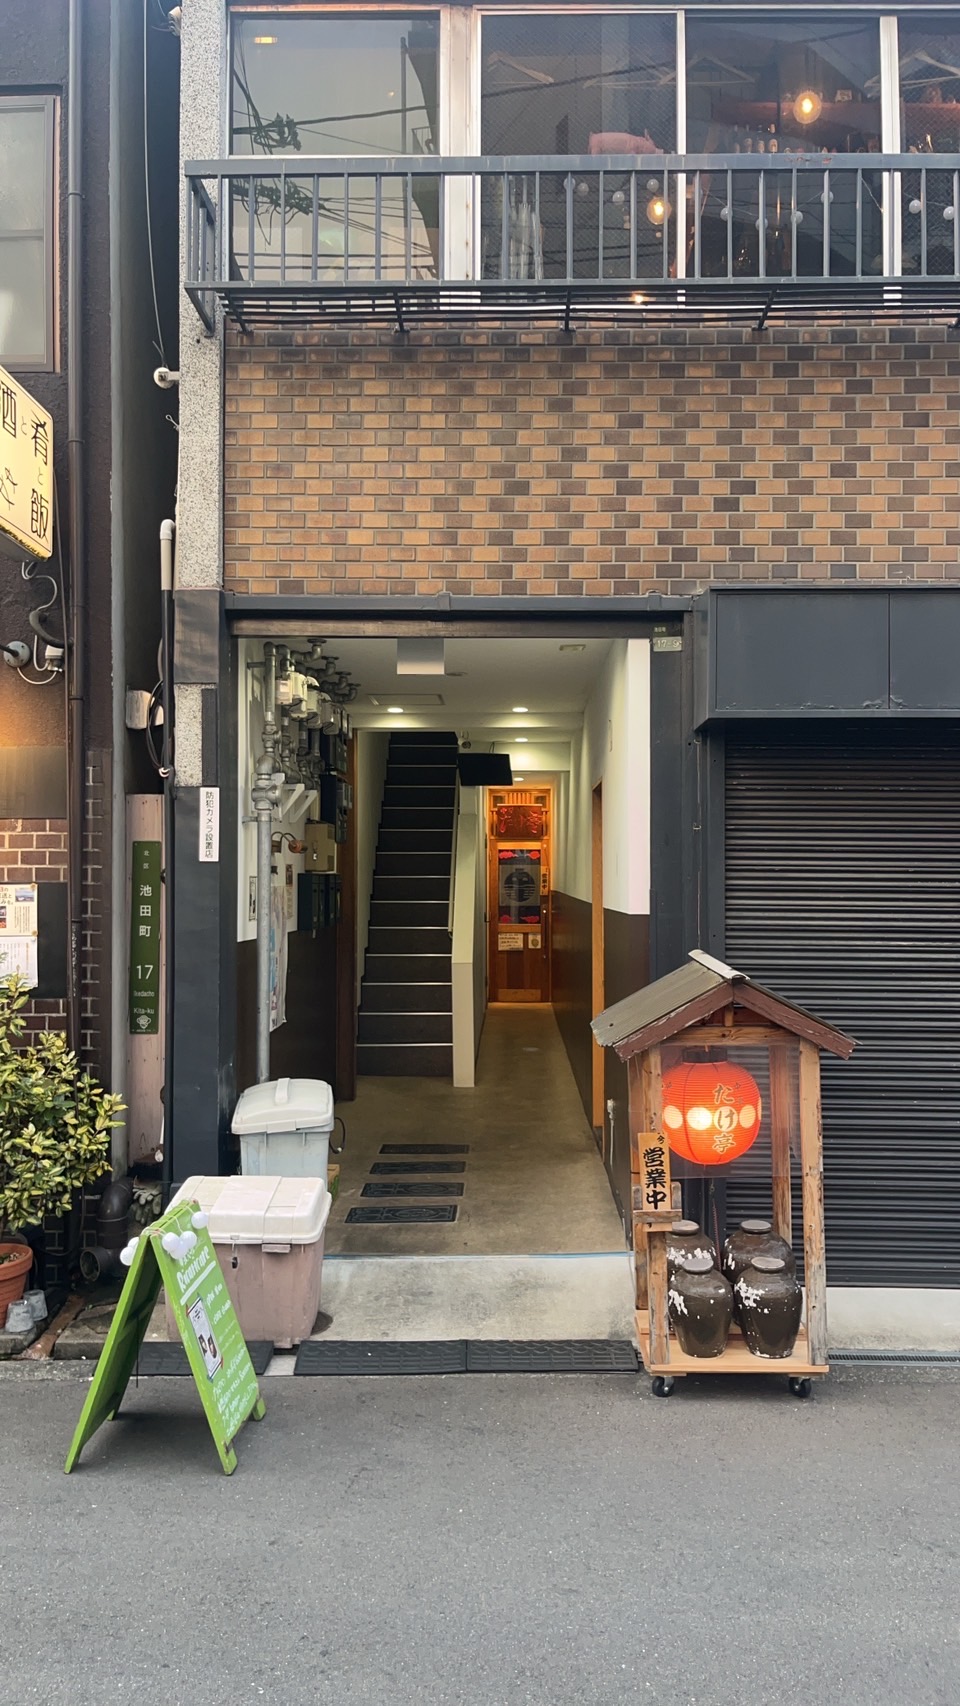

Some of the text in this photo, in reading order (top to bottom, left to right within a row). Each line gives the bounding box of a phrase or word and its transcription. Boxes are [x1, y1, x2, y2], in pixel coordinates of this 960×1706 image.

[205, 791, 214, 859] 防犯カメラ設置店
[139, 884, 152, 938] 池田町
[136, 964, 154, 980] 17
[711, 1083, 736, 1154] たけ亭
[643, 1146, 667, 1210] 営業中
